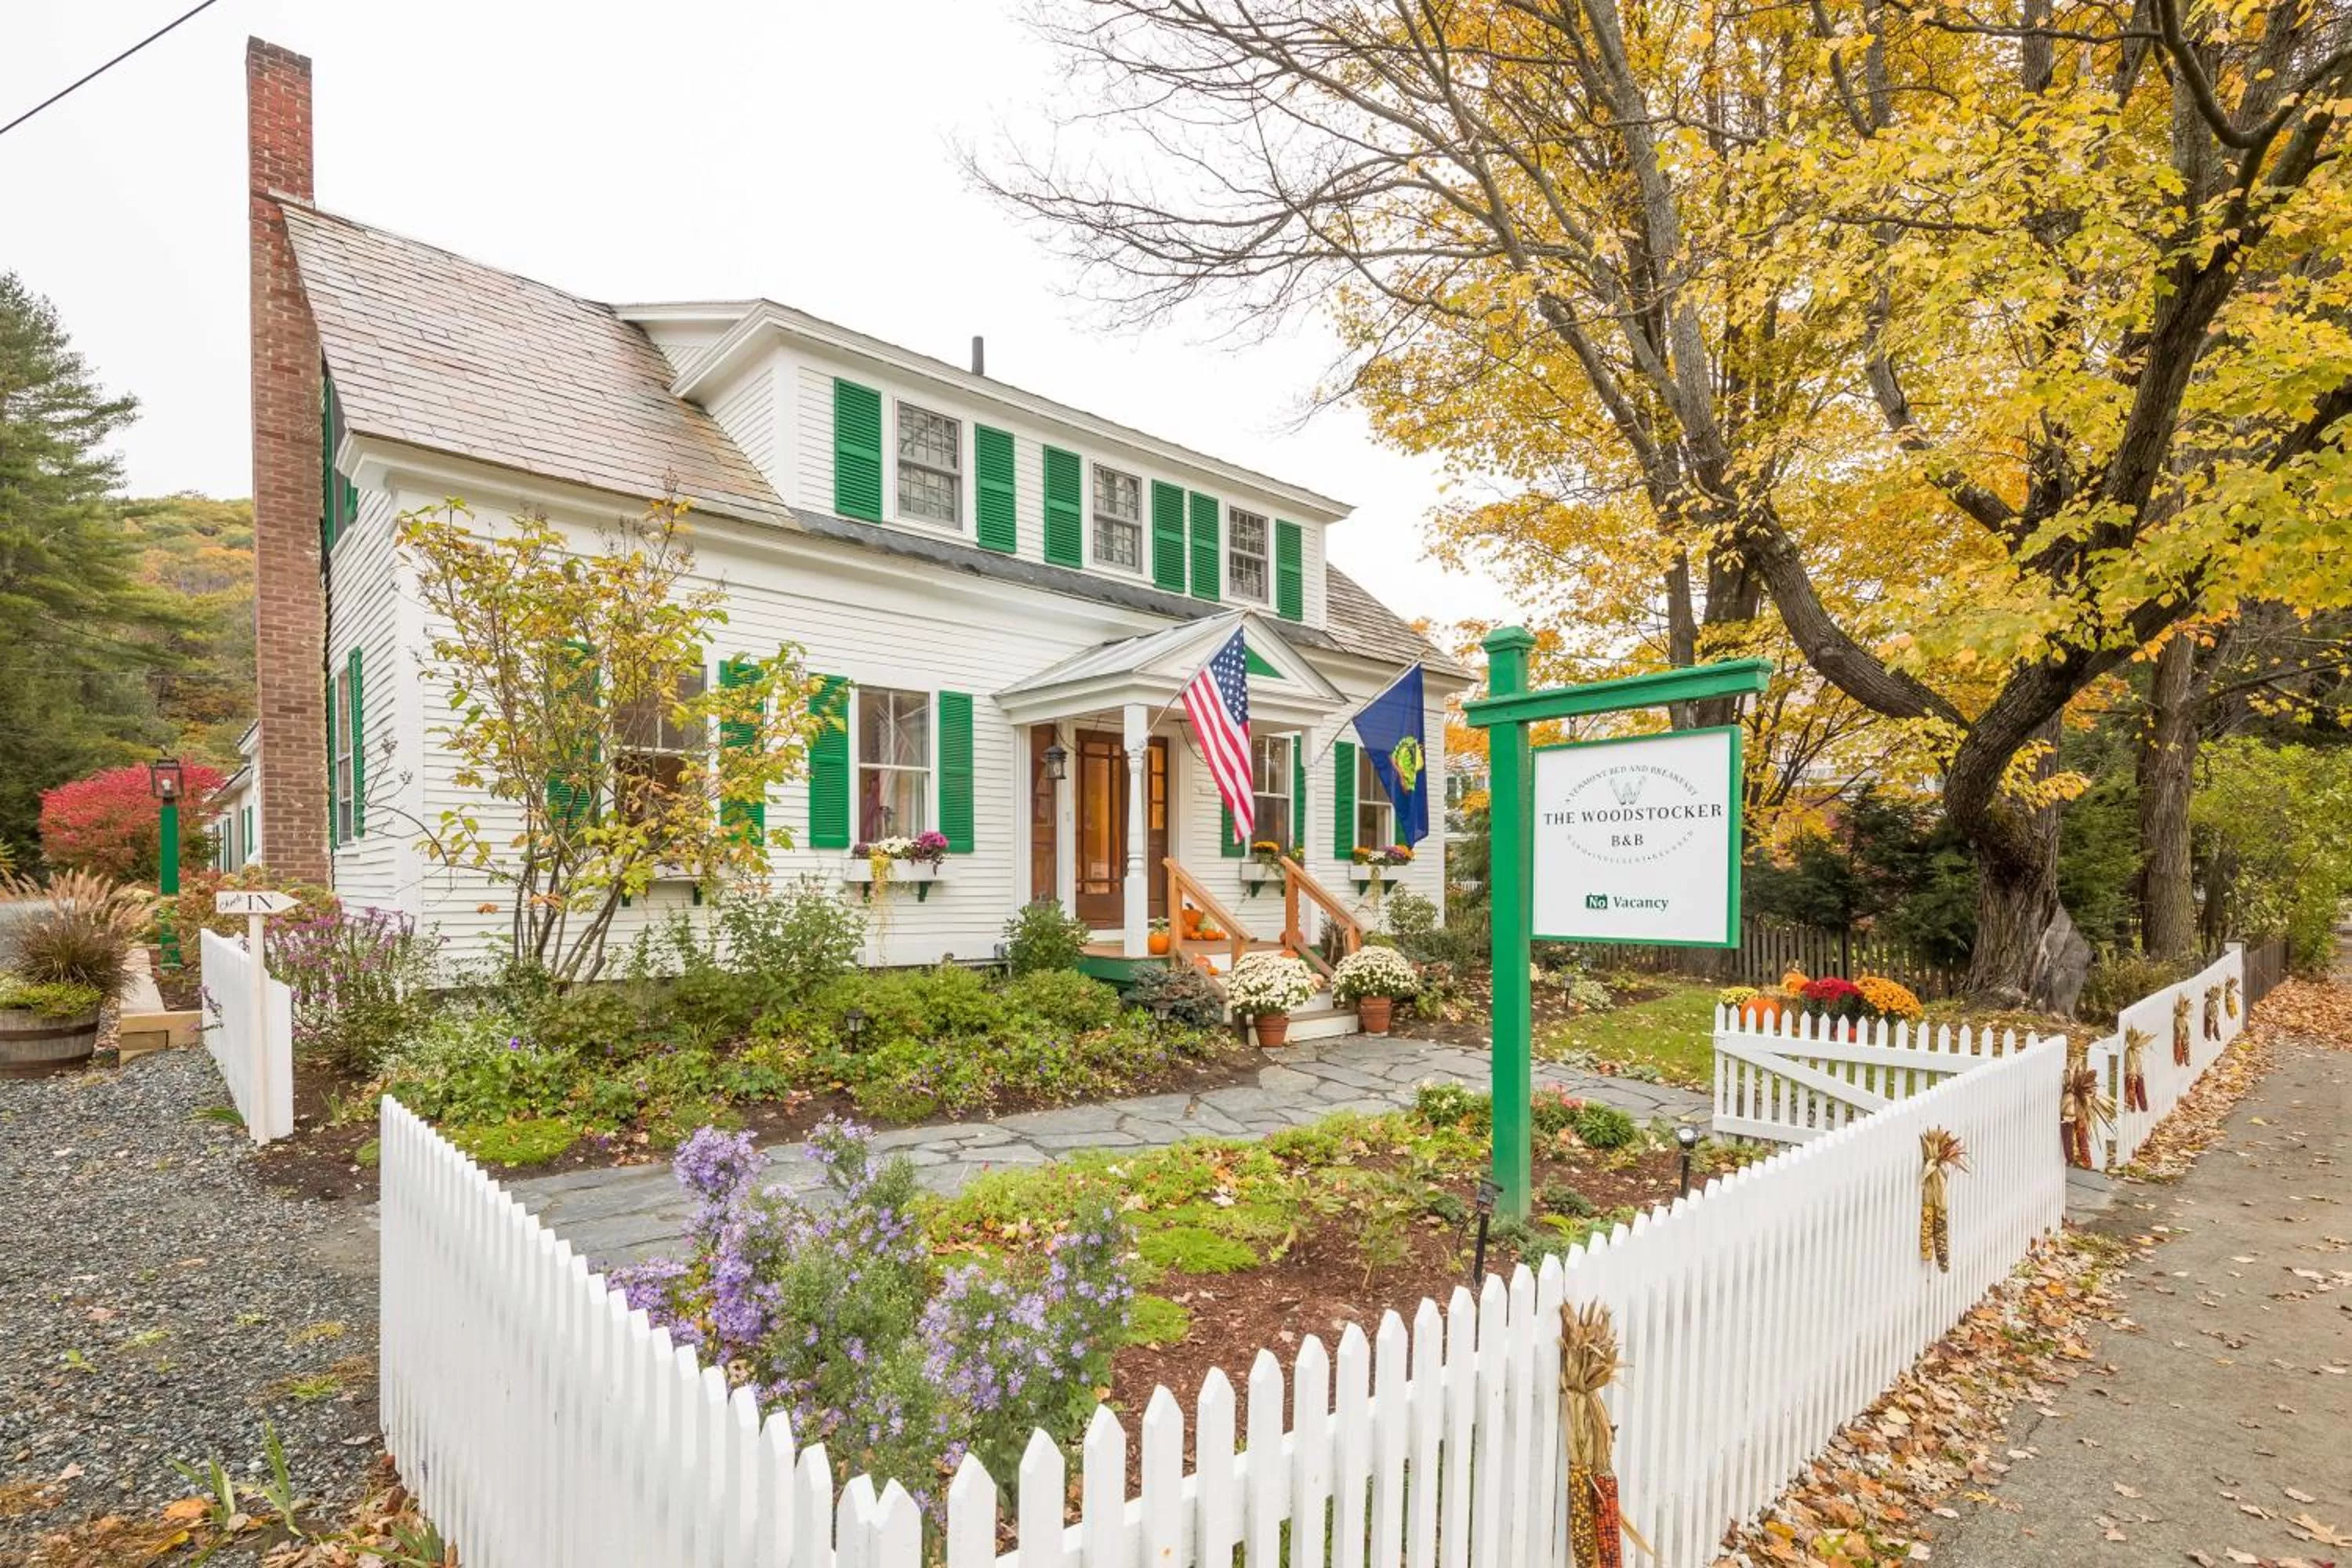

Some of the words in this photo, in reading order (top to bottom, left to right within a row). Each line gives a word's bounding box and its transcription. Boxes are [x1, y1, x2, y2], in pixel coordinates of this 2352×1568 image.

[1610, 765, 1627, 775] BED
[1543, 811, 1575, 826] THE
[1581, 804, 1722, 823] WOODSTOCKER
[1611, 833, 1644, 848] B&B
[247, 895, 274, 910] IN
[1588, 895, 1607, 908] No
[1613, 896, 1669, 912] Vacancy
